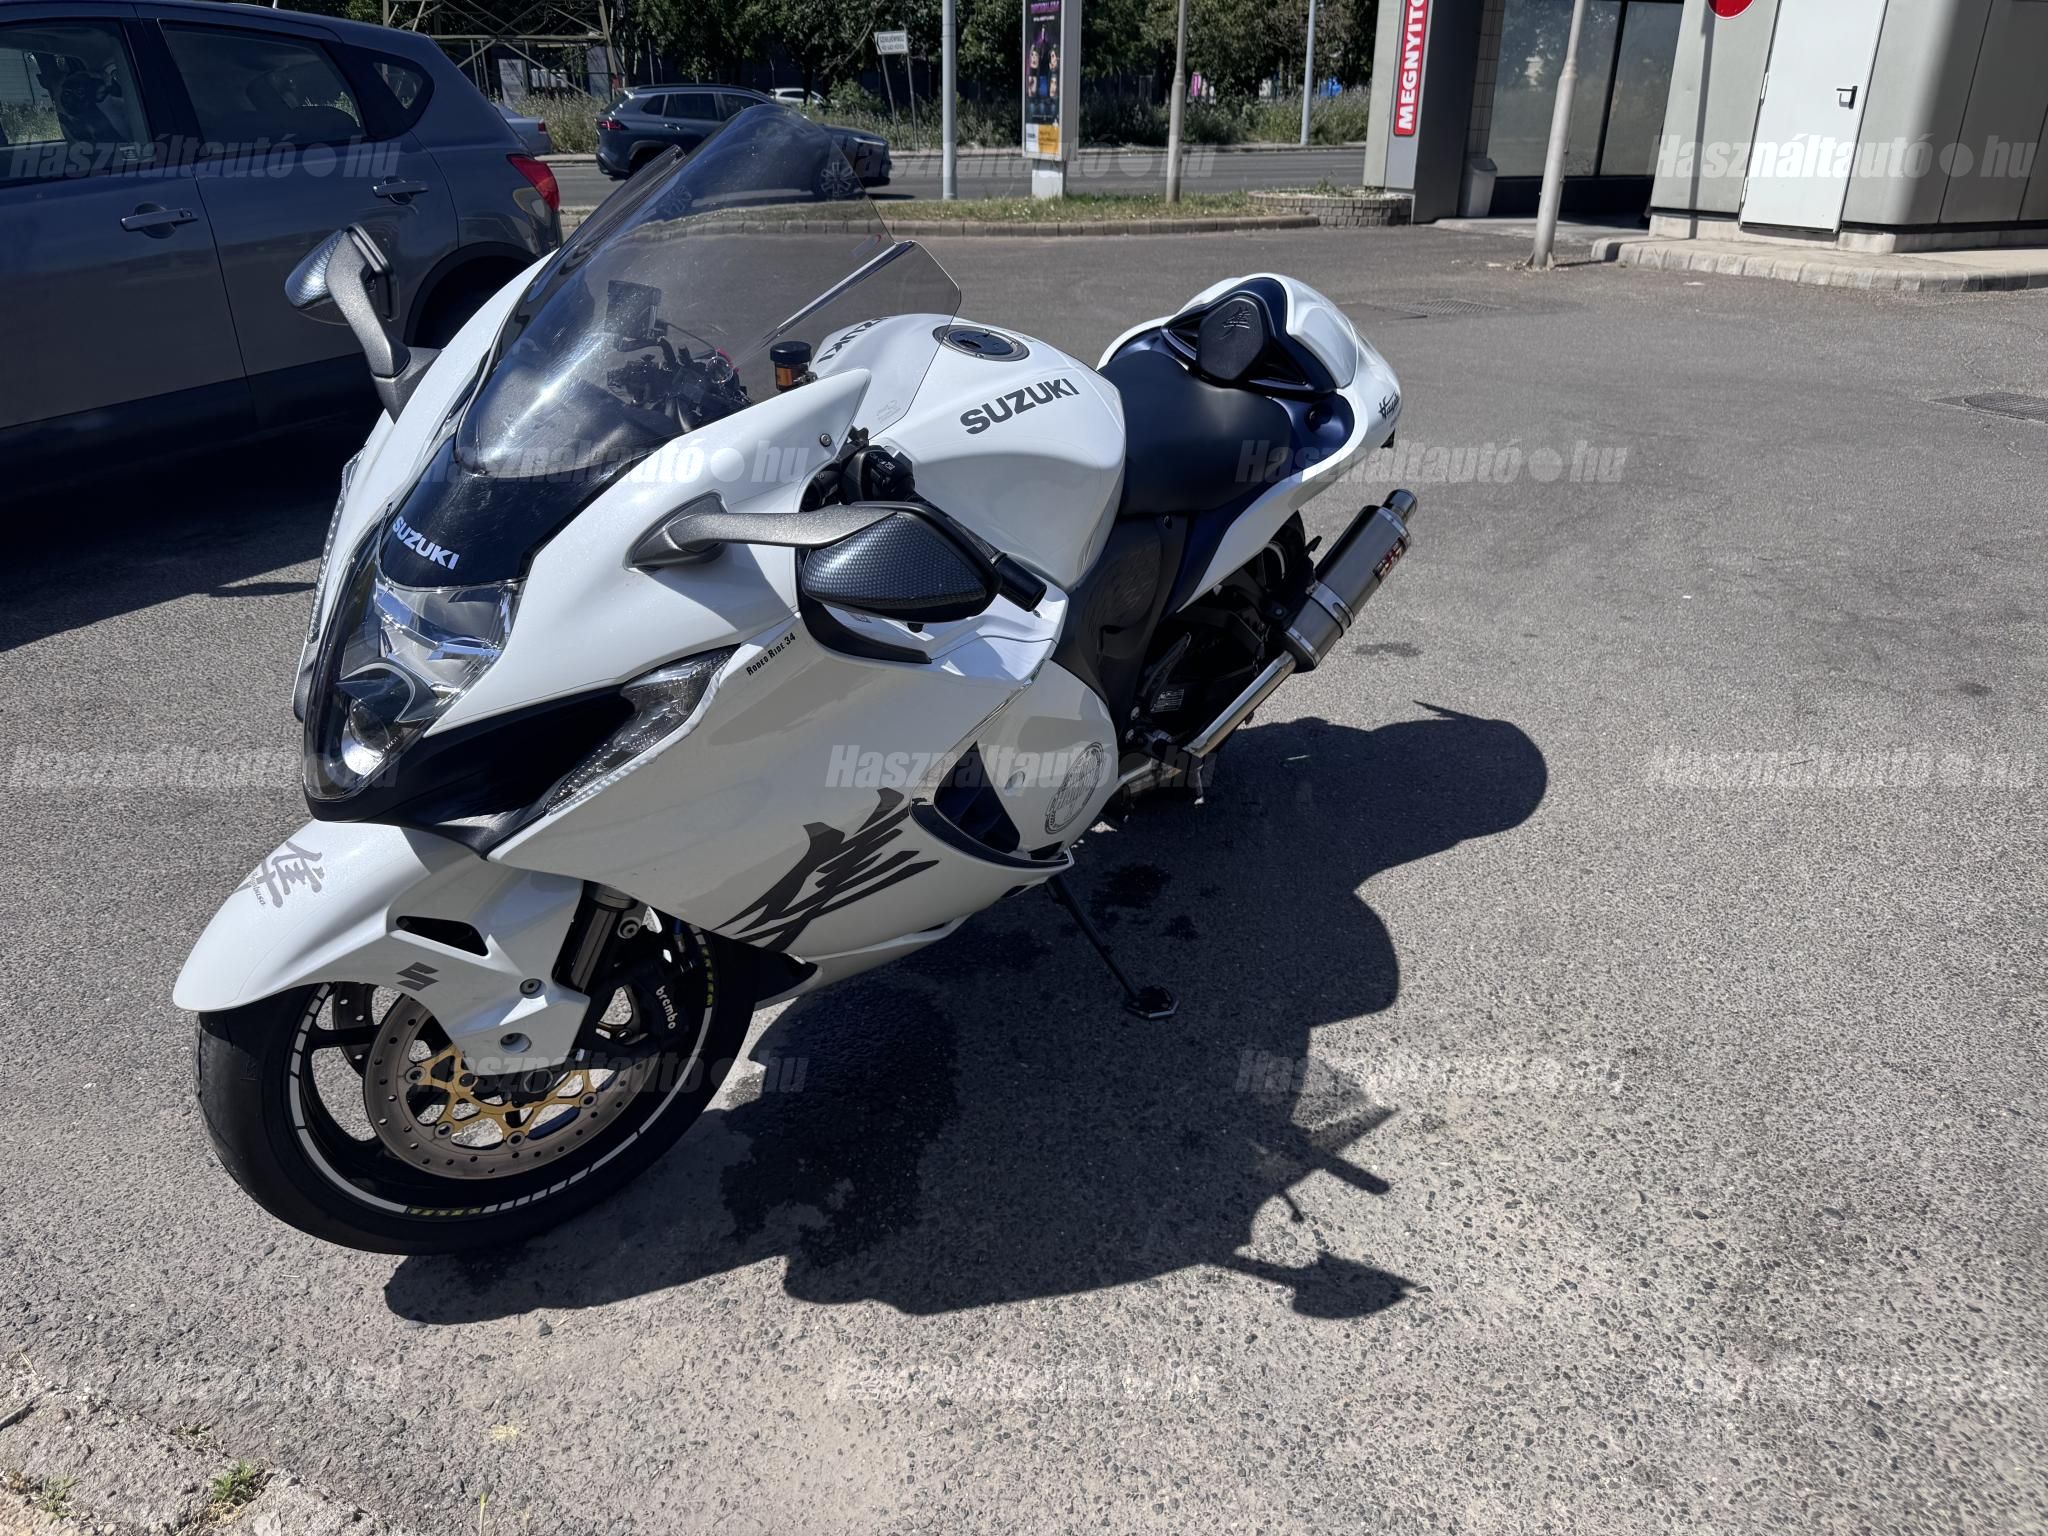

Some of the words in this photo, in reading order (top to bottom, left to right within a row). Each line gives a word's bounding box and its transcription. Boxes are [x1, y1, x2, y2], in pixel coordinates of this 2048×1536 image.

[817, 317, 889, 364] ZUKI
[960, 378, 1081, 435] SUZUKI
[392, 516, 460, 570] SUZUKI
[784, 632, 796, 646] 34
[655, 985, 679, 1030] brembo
